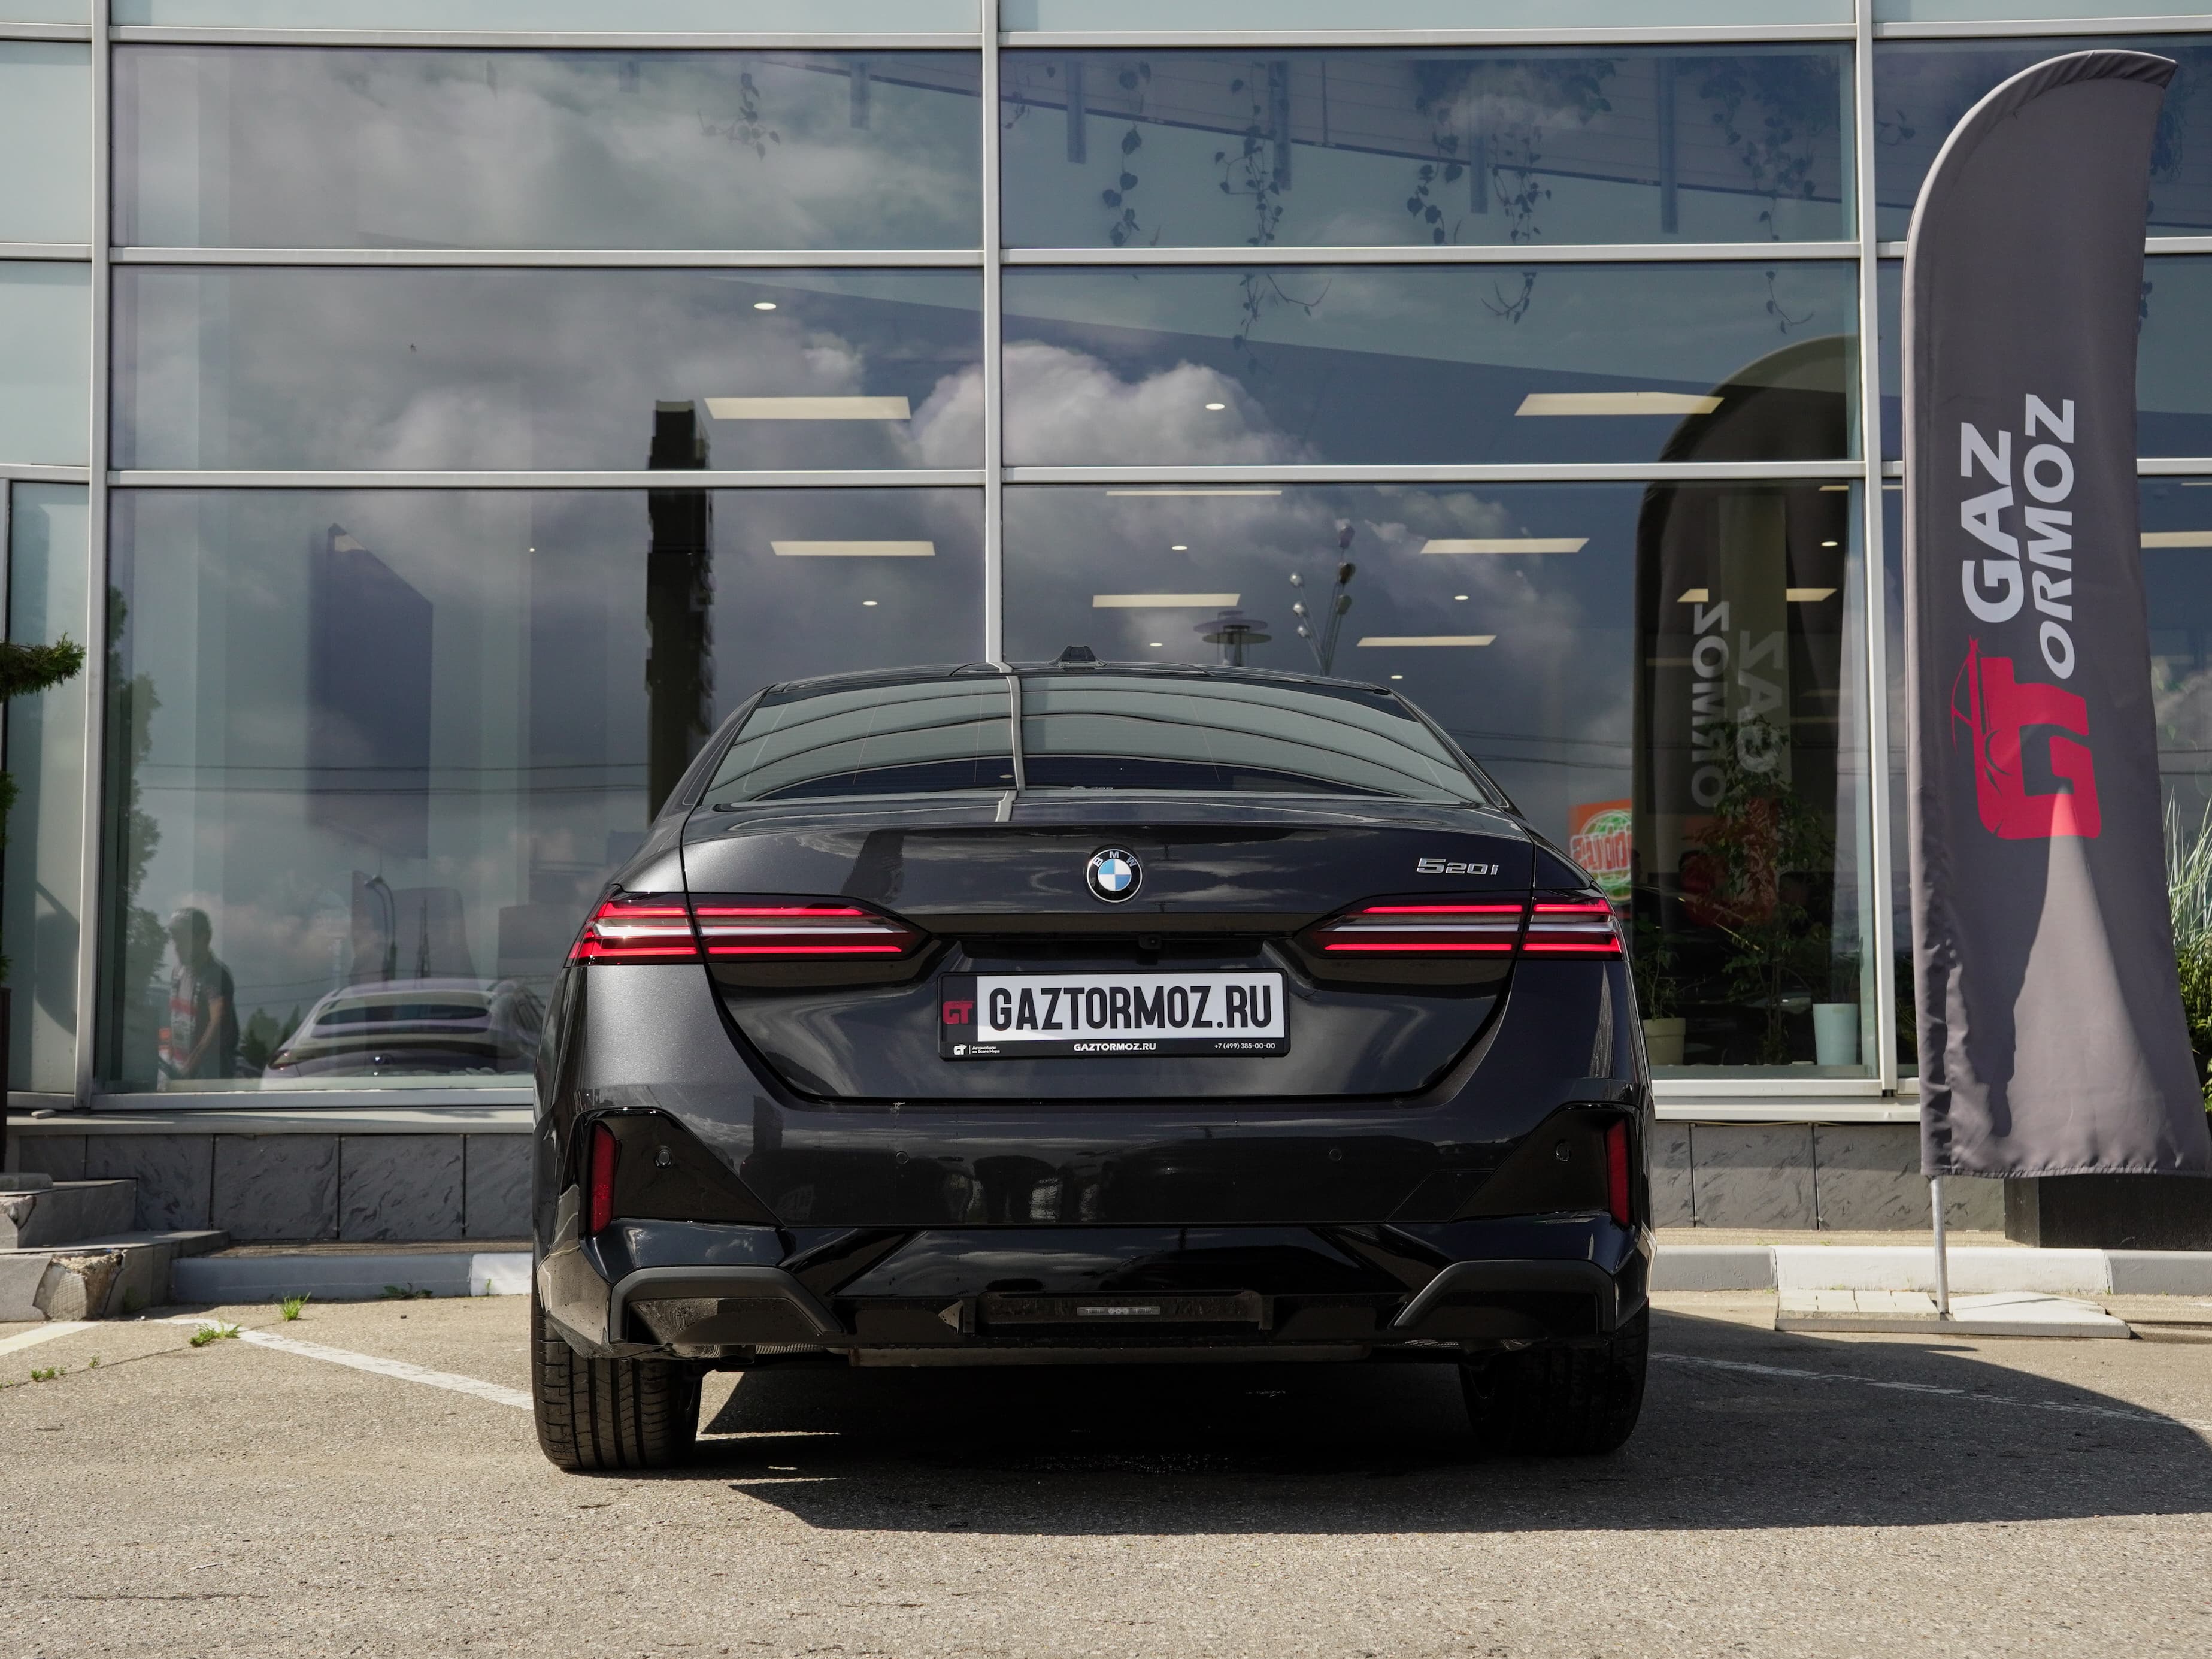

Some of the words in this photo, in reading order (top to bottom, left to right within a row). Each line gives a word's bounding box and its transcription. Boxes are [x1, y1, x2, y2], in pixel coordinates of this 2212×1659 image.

[1960, 422, 2025, 623] GAZ
[1092, 851, 1137, 867] BMW
[1416, 858, 1499, 875] 520i
[943, 1000, 974, 1024] GT
[989, 985, 1271, 1031] GAZTORMOZ.RU
[953, 1044, 967, 1055] GT
[1073, 1042, 1157, 1051] GAZTORMOZ.RU
